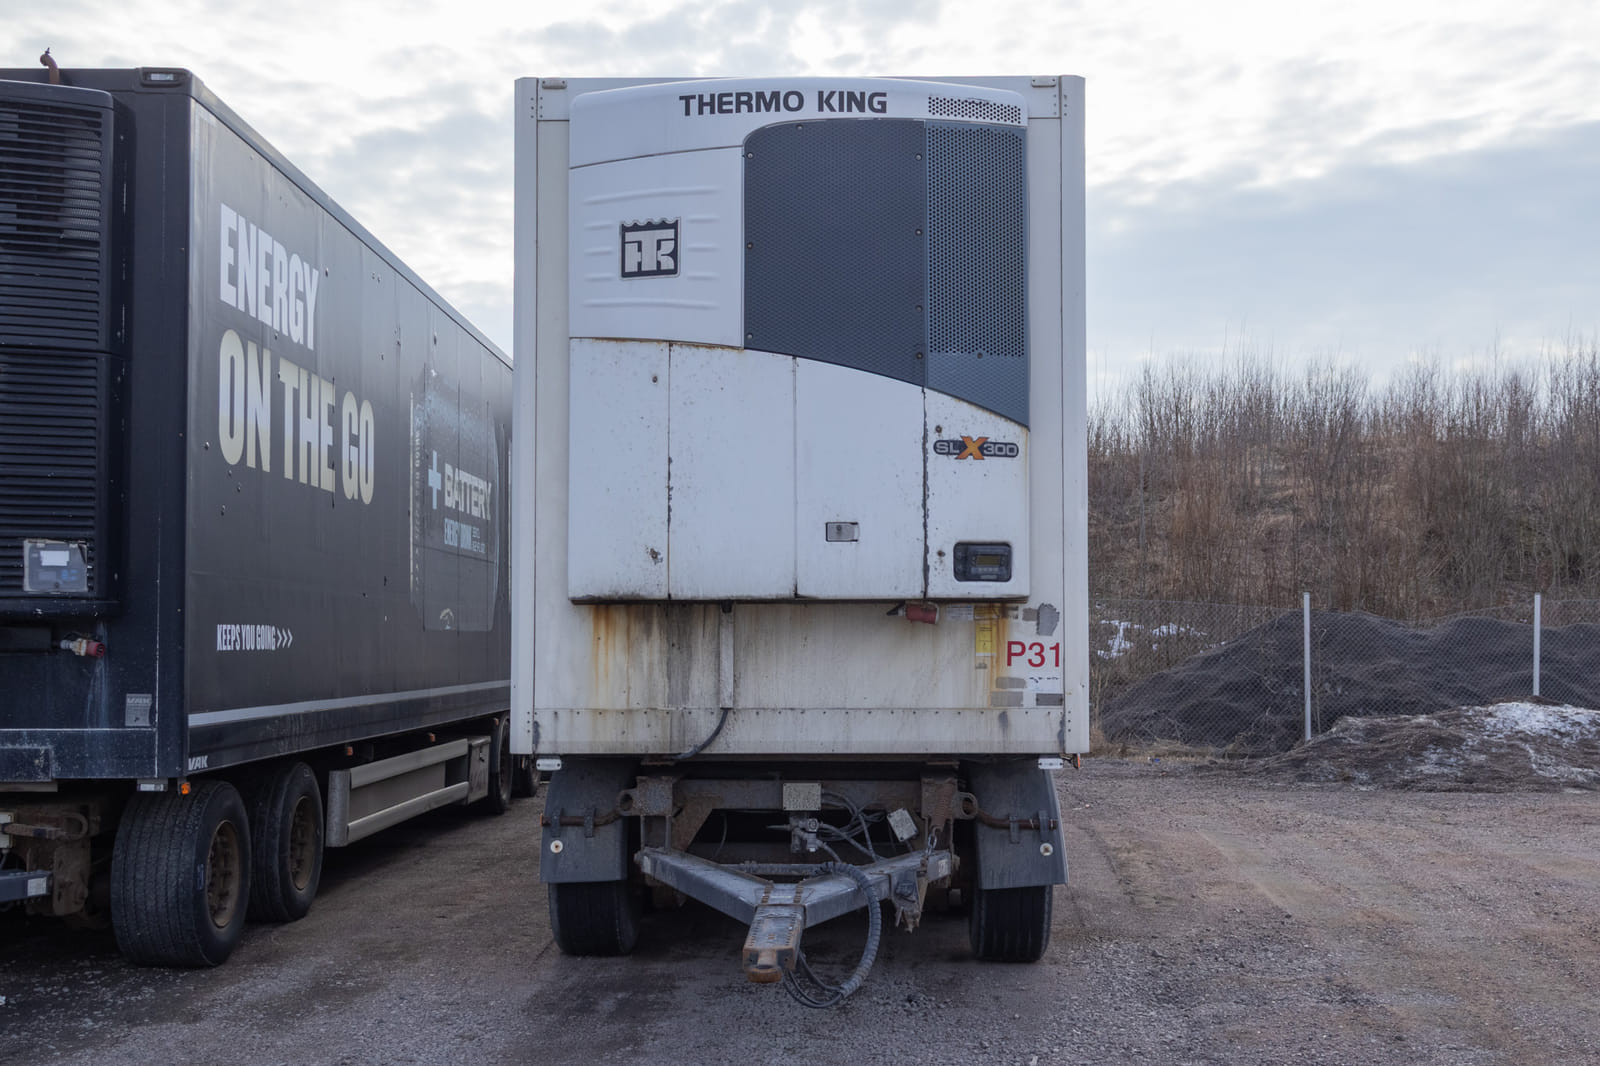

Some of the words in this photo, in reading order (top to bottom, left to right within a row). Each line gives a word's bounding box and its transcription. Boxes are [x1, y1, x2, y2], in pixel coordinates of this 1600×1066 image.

[679, 91, 804, 116] THERMO
[818, 91, 887, 114] KING
[220, 203, 319, 350] ENERGY
[219, 329, 271, 472] ON
[279, 356, 336, 493] THE
[342, 391, 375, 505] GO
[935, 435, 1018, 461] SLX300
[444, 463, 492, 520] BATTERY
[216, 624, 240, 651] KEEPS
[241, 624, 255, 650] YOU
[256, 625, 276, 650] GOING
[1007, 641, 1060, 667] P31
[188, 755, 208, 771] VAK
